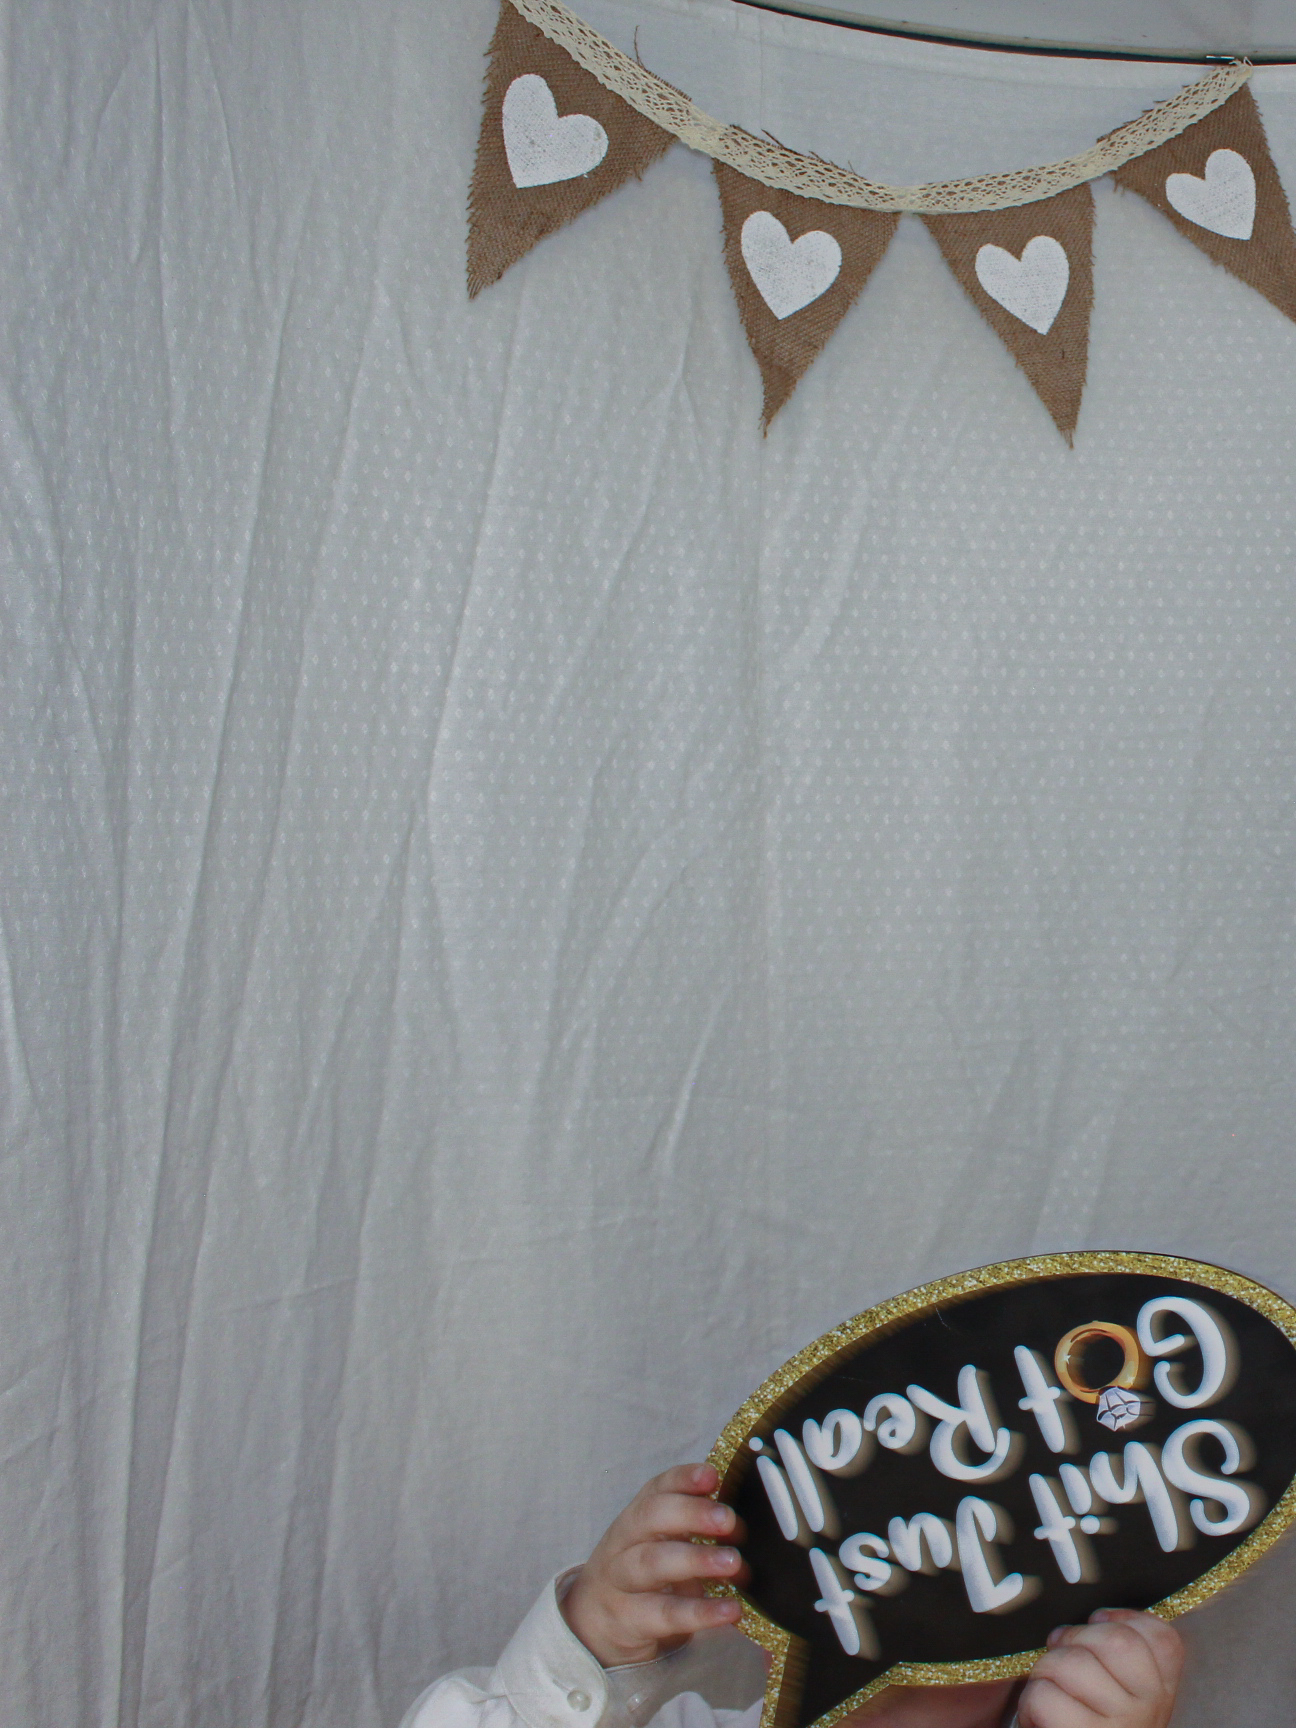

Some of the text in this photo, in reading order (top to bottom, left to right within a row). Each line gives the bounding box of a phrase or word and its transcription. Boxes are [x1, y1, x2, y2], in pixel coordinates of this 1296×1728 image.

[748, 1364, 1011, 1541] Real!
[809, 1419, 1251, 1656] Shit Just
